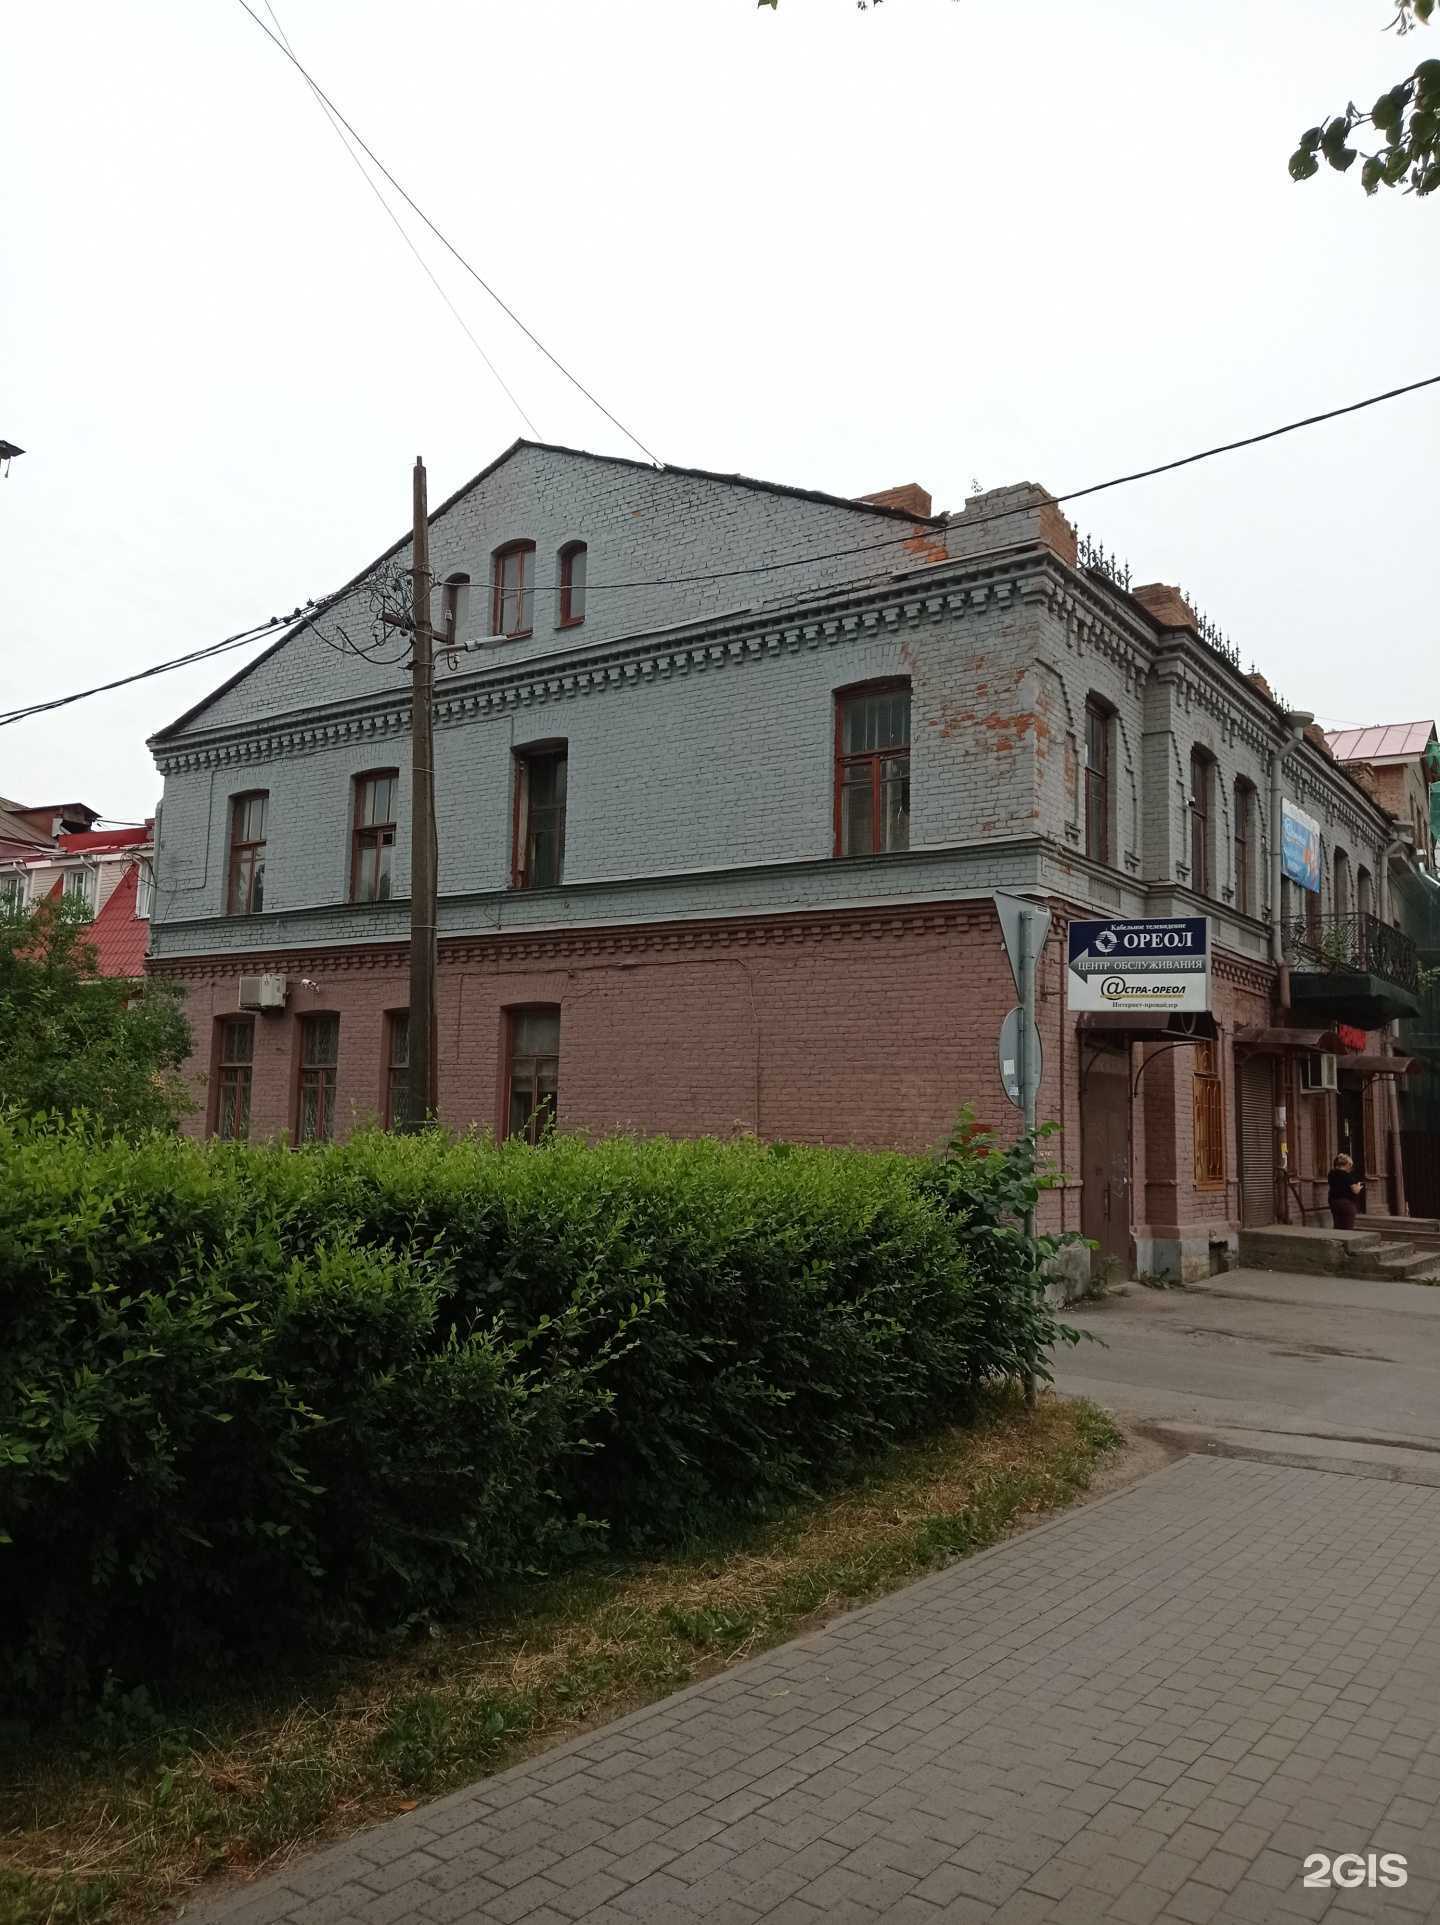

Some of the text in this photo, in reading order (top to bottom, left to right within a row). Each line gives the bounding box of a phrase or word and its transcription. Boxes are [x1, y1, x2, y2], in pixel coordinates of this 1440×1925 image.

[1123, 932, 1193, 948] ОРЕОЛ
[1078, 960, 1203, 971] ЦЕНТР ОБСЛУЖИВАНИЯ
